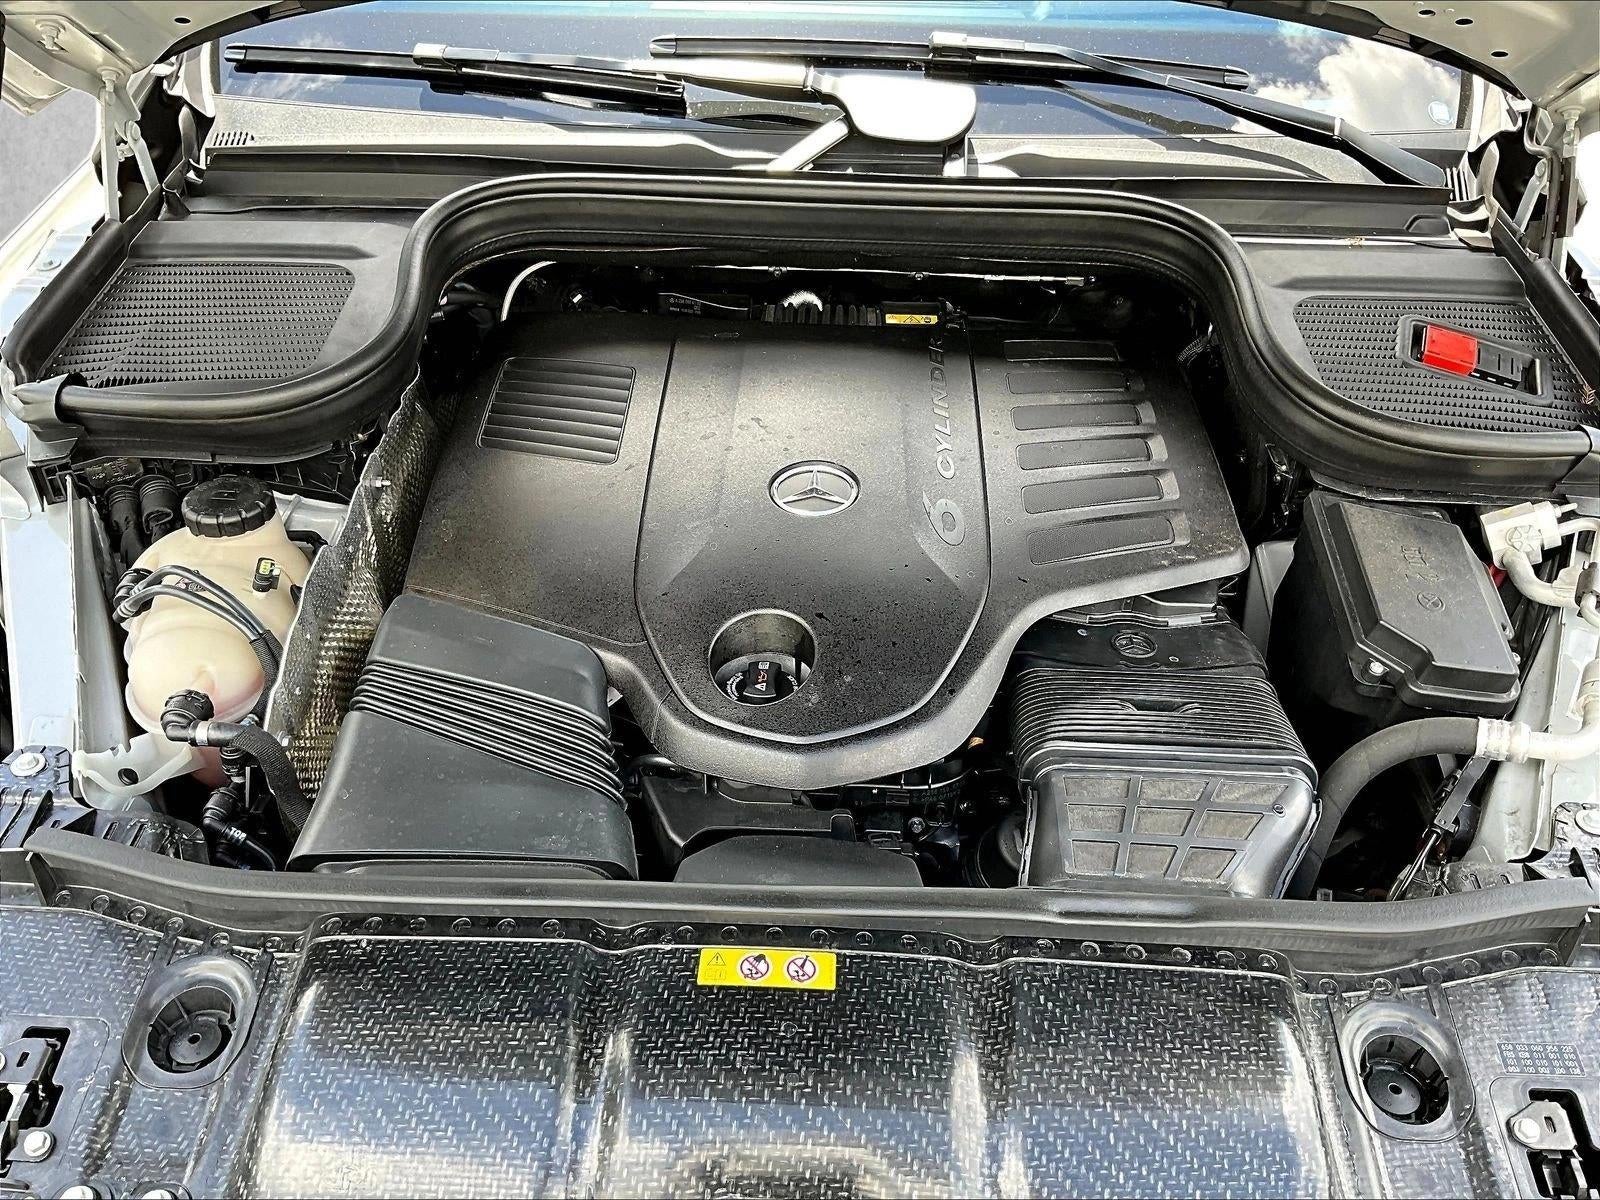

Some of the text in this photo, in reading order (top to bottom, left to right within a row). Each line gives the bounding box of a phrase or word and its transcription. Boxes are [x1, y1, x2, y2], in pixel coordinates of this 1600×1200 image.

[922, 336, 966, 547] 6 CYLINDER
[229, 826, 247, 842] TOP
